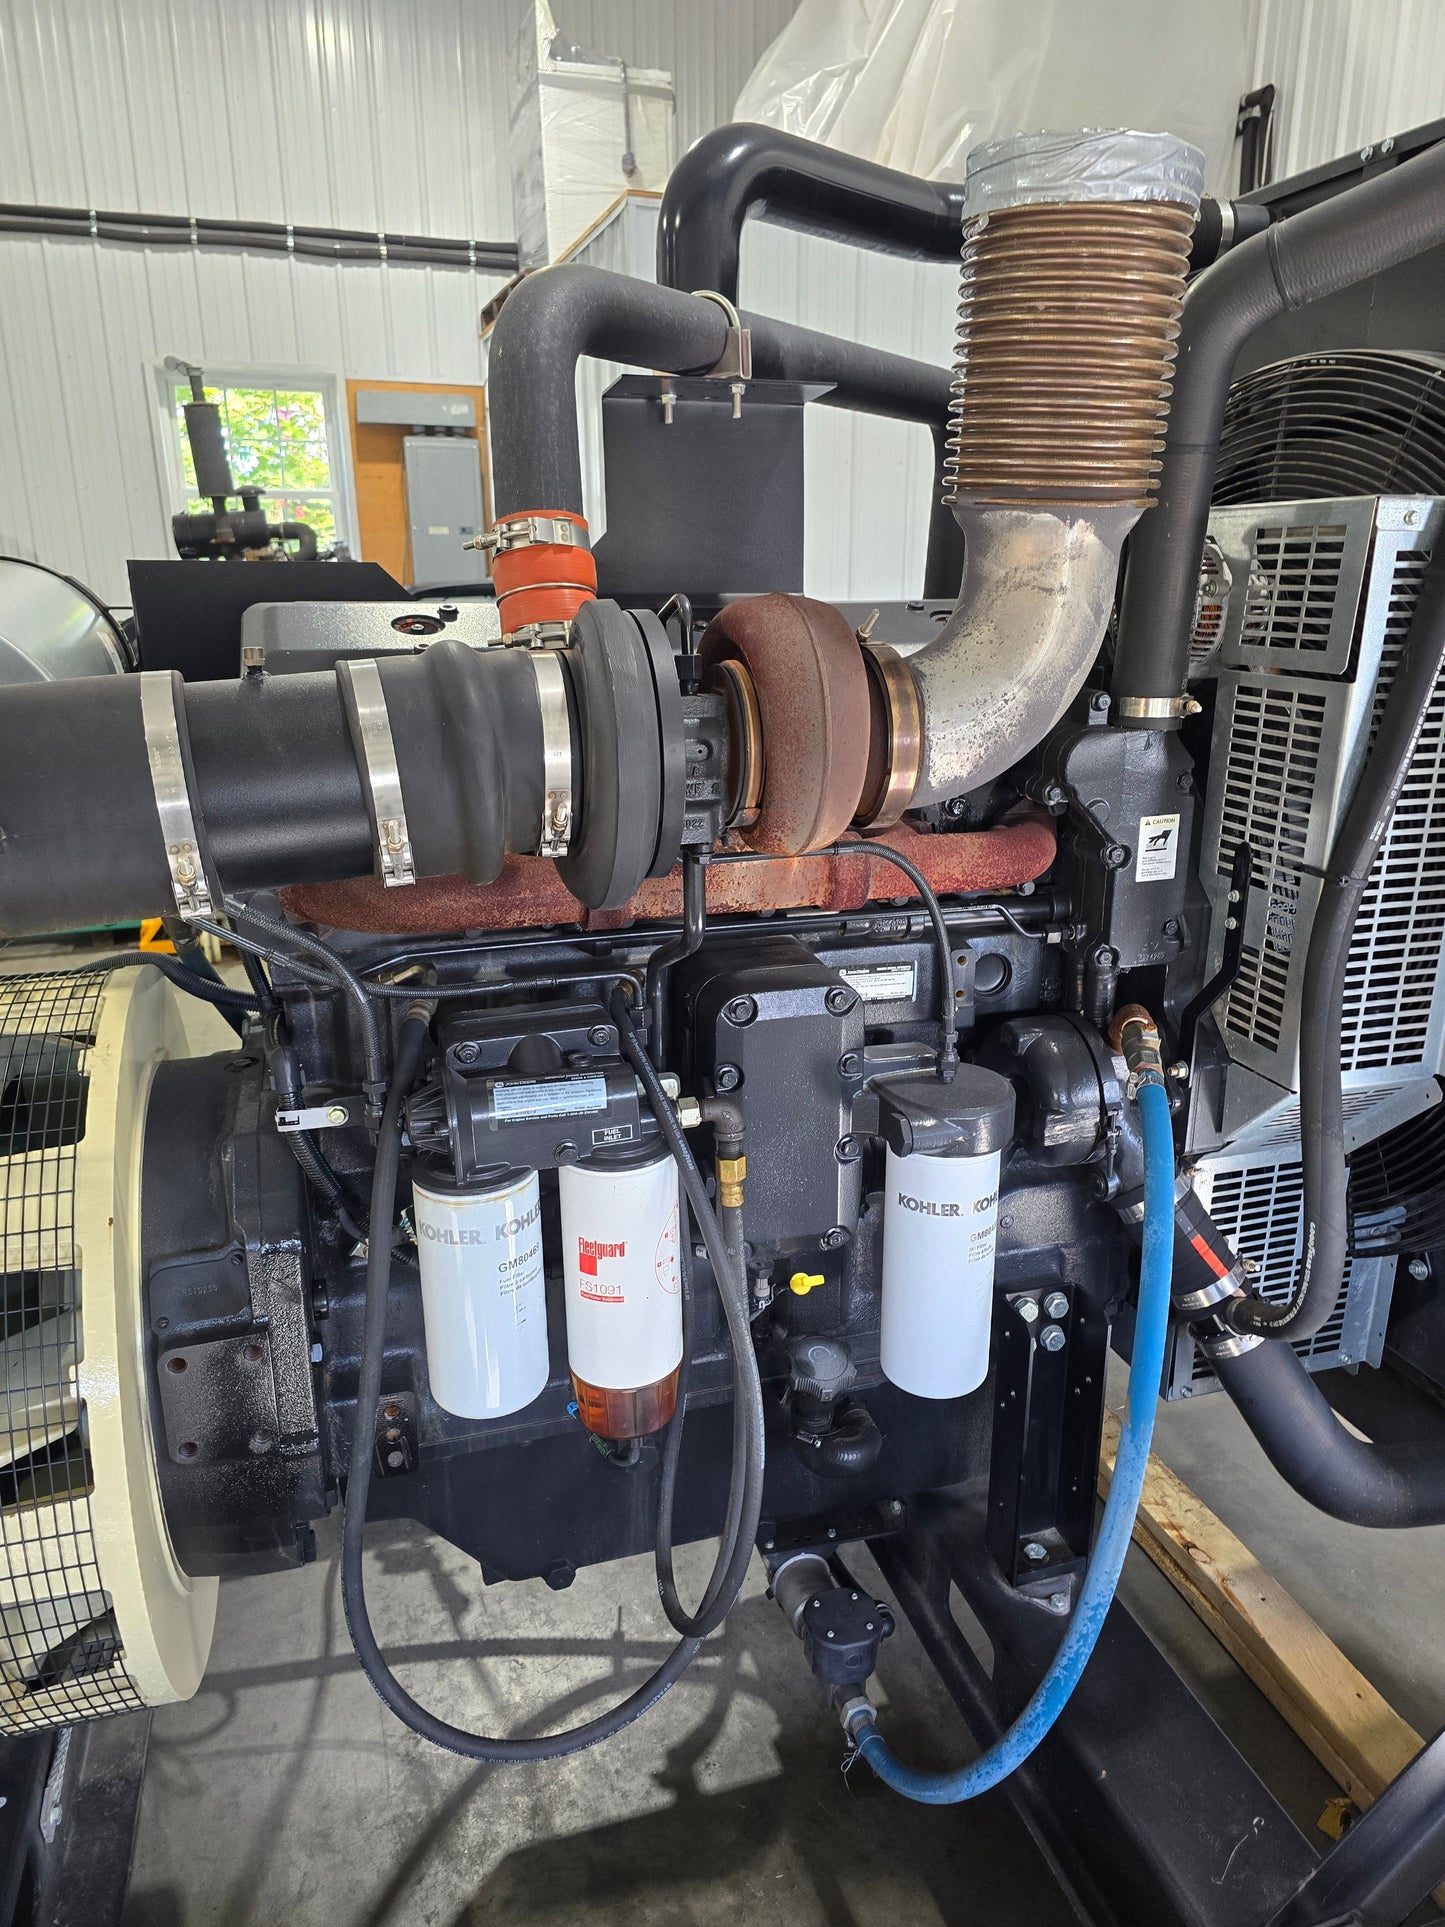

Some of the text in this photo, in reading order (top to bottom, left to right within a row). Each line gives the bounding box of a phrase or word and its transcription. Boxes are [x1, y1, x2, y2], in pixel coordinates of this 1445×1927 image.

[578, 1236, 625, 1260] Fleetguard
[1306, 1222, 1316, 1271] GOODYEAR
[500, 1270, 525, 1284] Fuel Filter
[579, 1279, 622, 1295] FS1091
[617, 1720, 631, 1732] USA
